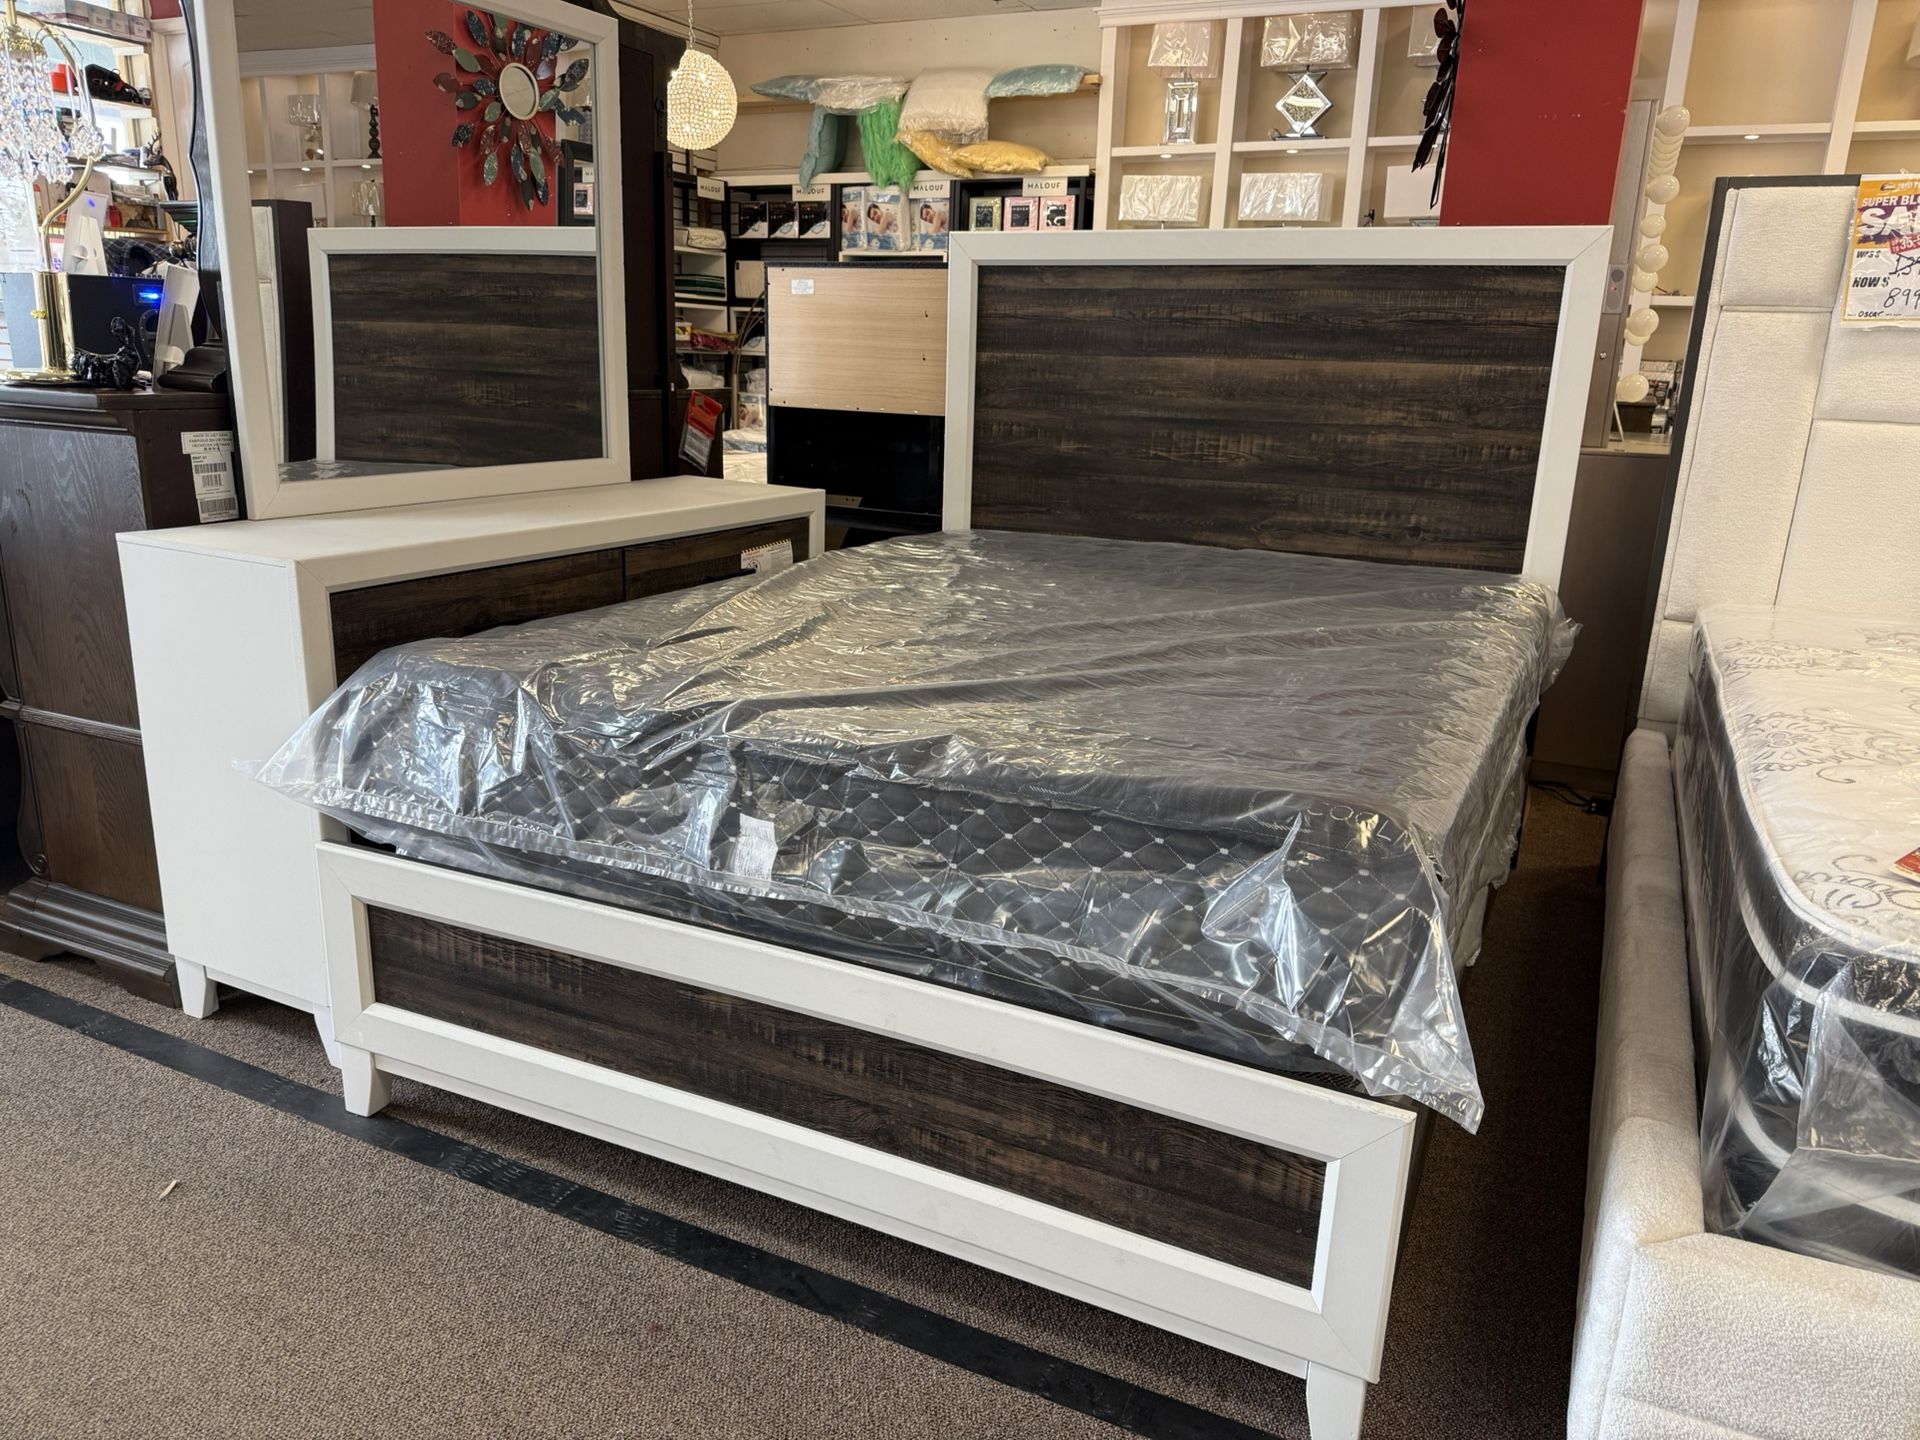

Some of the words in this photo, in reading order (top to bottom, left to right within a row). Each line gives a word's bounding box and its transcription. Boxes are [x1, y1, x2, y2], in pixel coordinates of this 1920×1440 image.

[913, 184, 944, 192] MALOUF
[1027, 182, 1060, 190] MALOUF
[1862, 196, 1898, 207] SUPER
[1852, 276, 1881, 288] NOW
